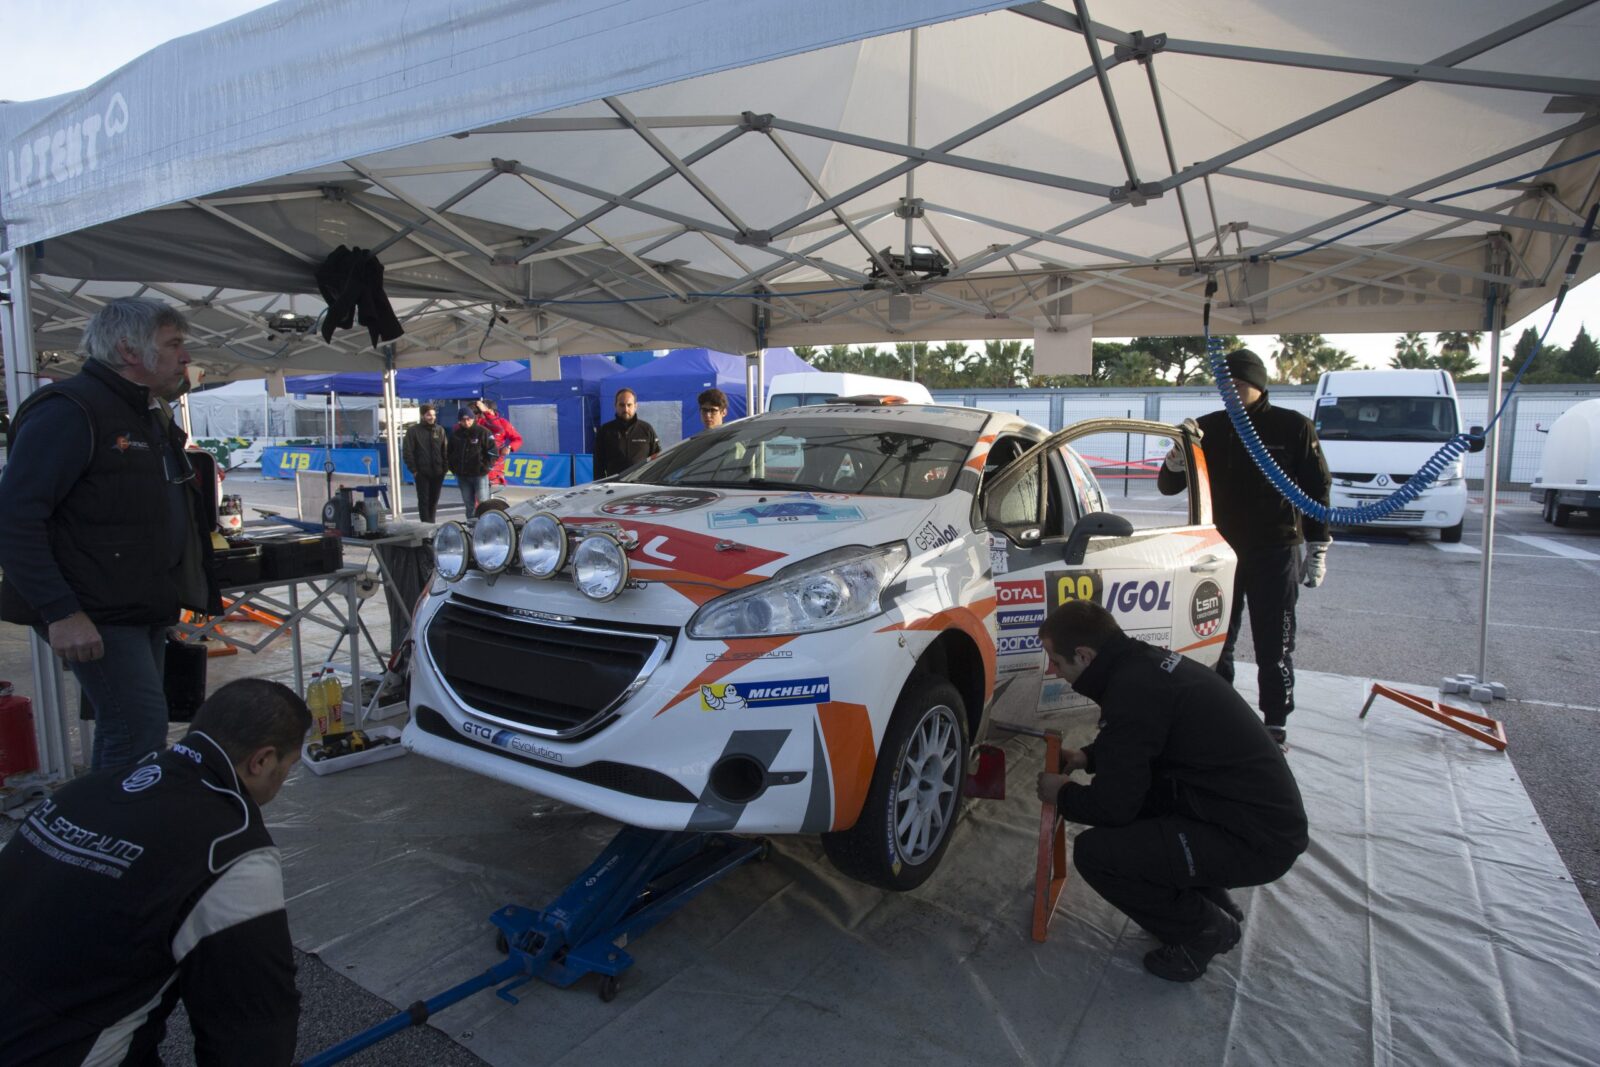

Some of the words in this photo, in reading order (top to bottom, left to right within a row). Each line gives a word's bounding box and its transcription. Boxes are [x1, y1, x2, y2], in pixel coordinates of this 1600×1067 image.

[280, 452, 310, 470] LTB
[504, 458, 543, 479] LTB
[1105, 580, 1171, 614] IGOL
[1195, 596, 1219, 613] tsm
[1001, 613, 1044, 624] MICHELIN
[1132, 631, 1169, 641] OGISTIQUE
[1277, 645, 1293, 705] PEUGET
[748, 684, 828, 699] MICHELIN
[511, 736, 563, 763] Evolution
[49, 815, 98, 845] SPORT
[88, 834, 144, 862] AUTO
